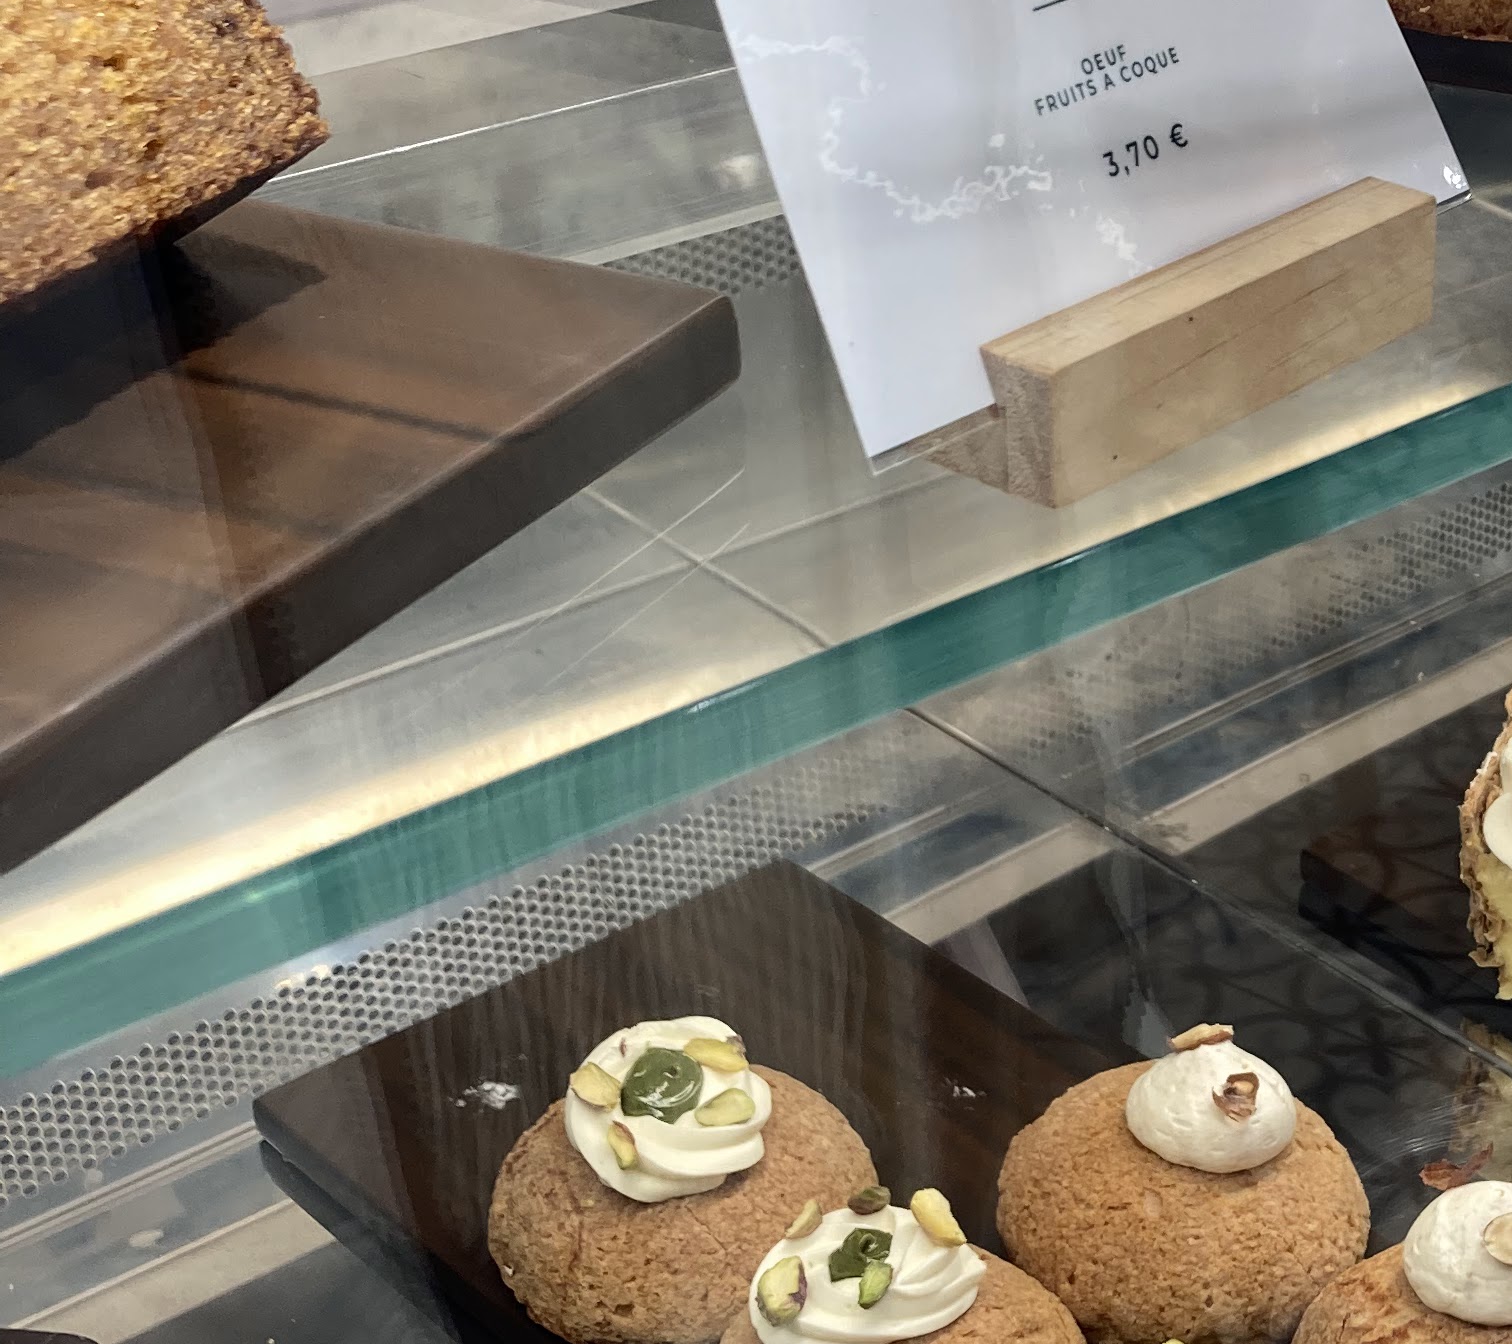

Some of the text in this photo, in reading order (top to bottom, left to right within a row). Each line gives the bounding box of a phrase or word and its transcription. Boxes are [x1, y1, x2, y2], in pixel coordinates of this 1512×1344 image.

[1034, 47, 1179, 116] FRUITS A COQUE
[1081, 44, 1127, 74] OEUF
[1103, 123, 1188, 177] 3,70 €
